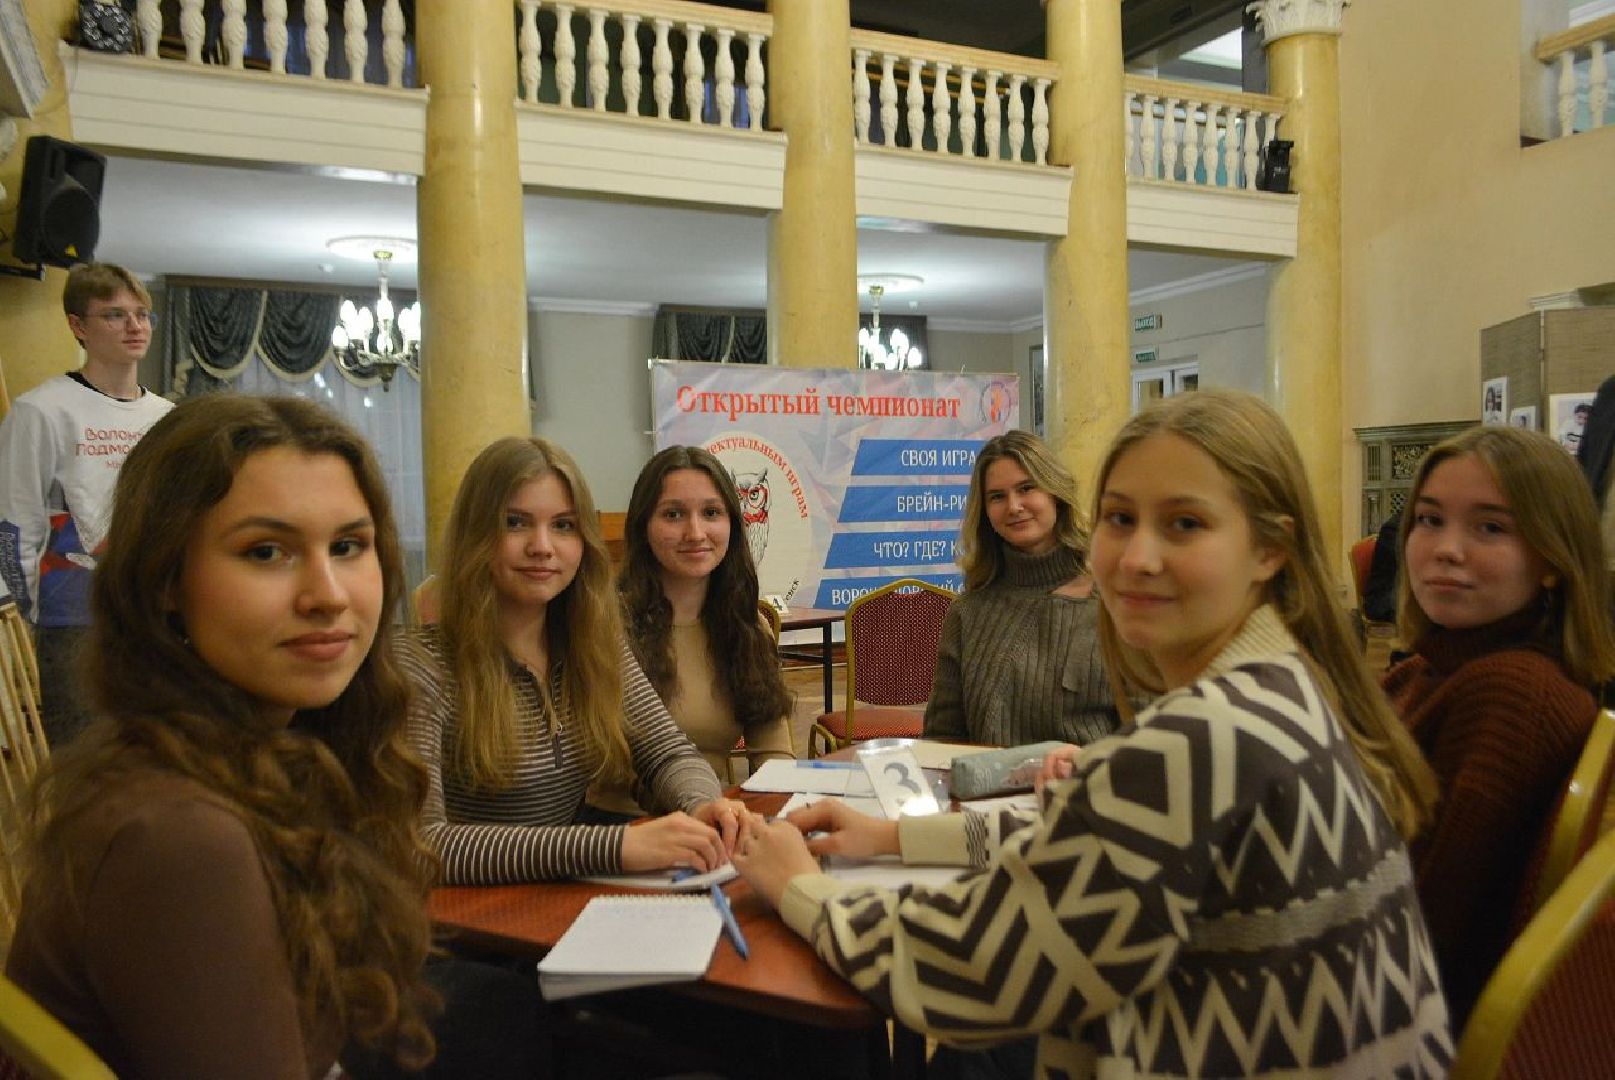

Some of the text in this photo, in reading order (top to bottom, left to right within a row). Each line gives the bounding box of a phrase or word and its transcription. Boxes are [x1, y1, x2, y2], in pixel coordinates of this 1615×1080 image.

[676, 386, 820, 421] Открытый
[827, 394, 961, 417] чемпионат
[75, 442, 130, 456] Подмо
[706, 437, 787, 470] ектуальным
[901, 449, 976, 467] СВОЯ ИГРА
[897, 491, 967, 513] БРЕЙН-РИ
[873, 541, 909, 559] ЧТО?
[914, 540, 947, 561] ГДЕ?
[883, 762, 922, 807] 3
